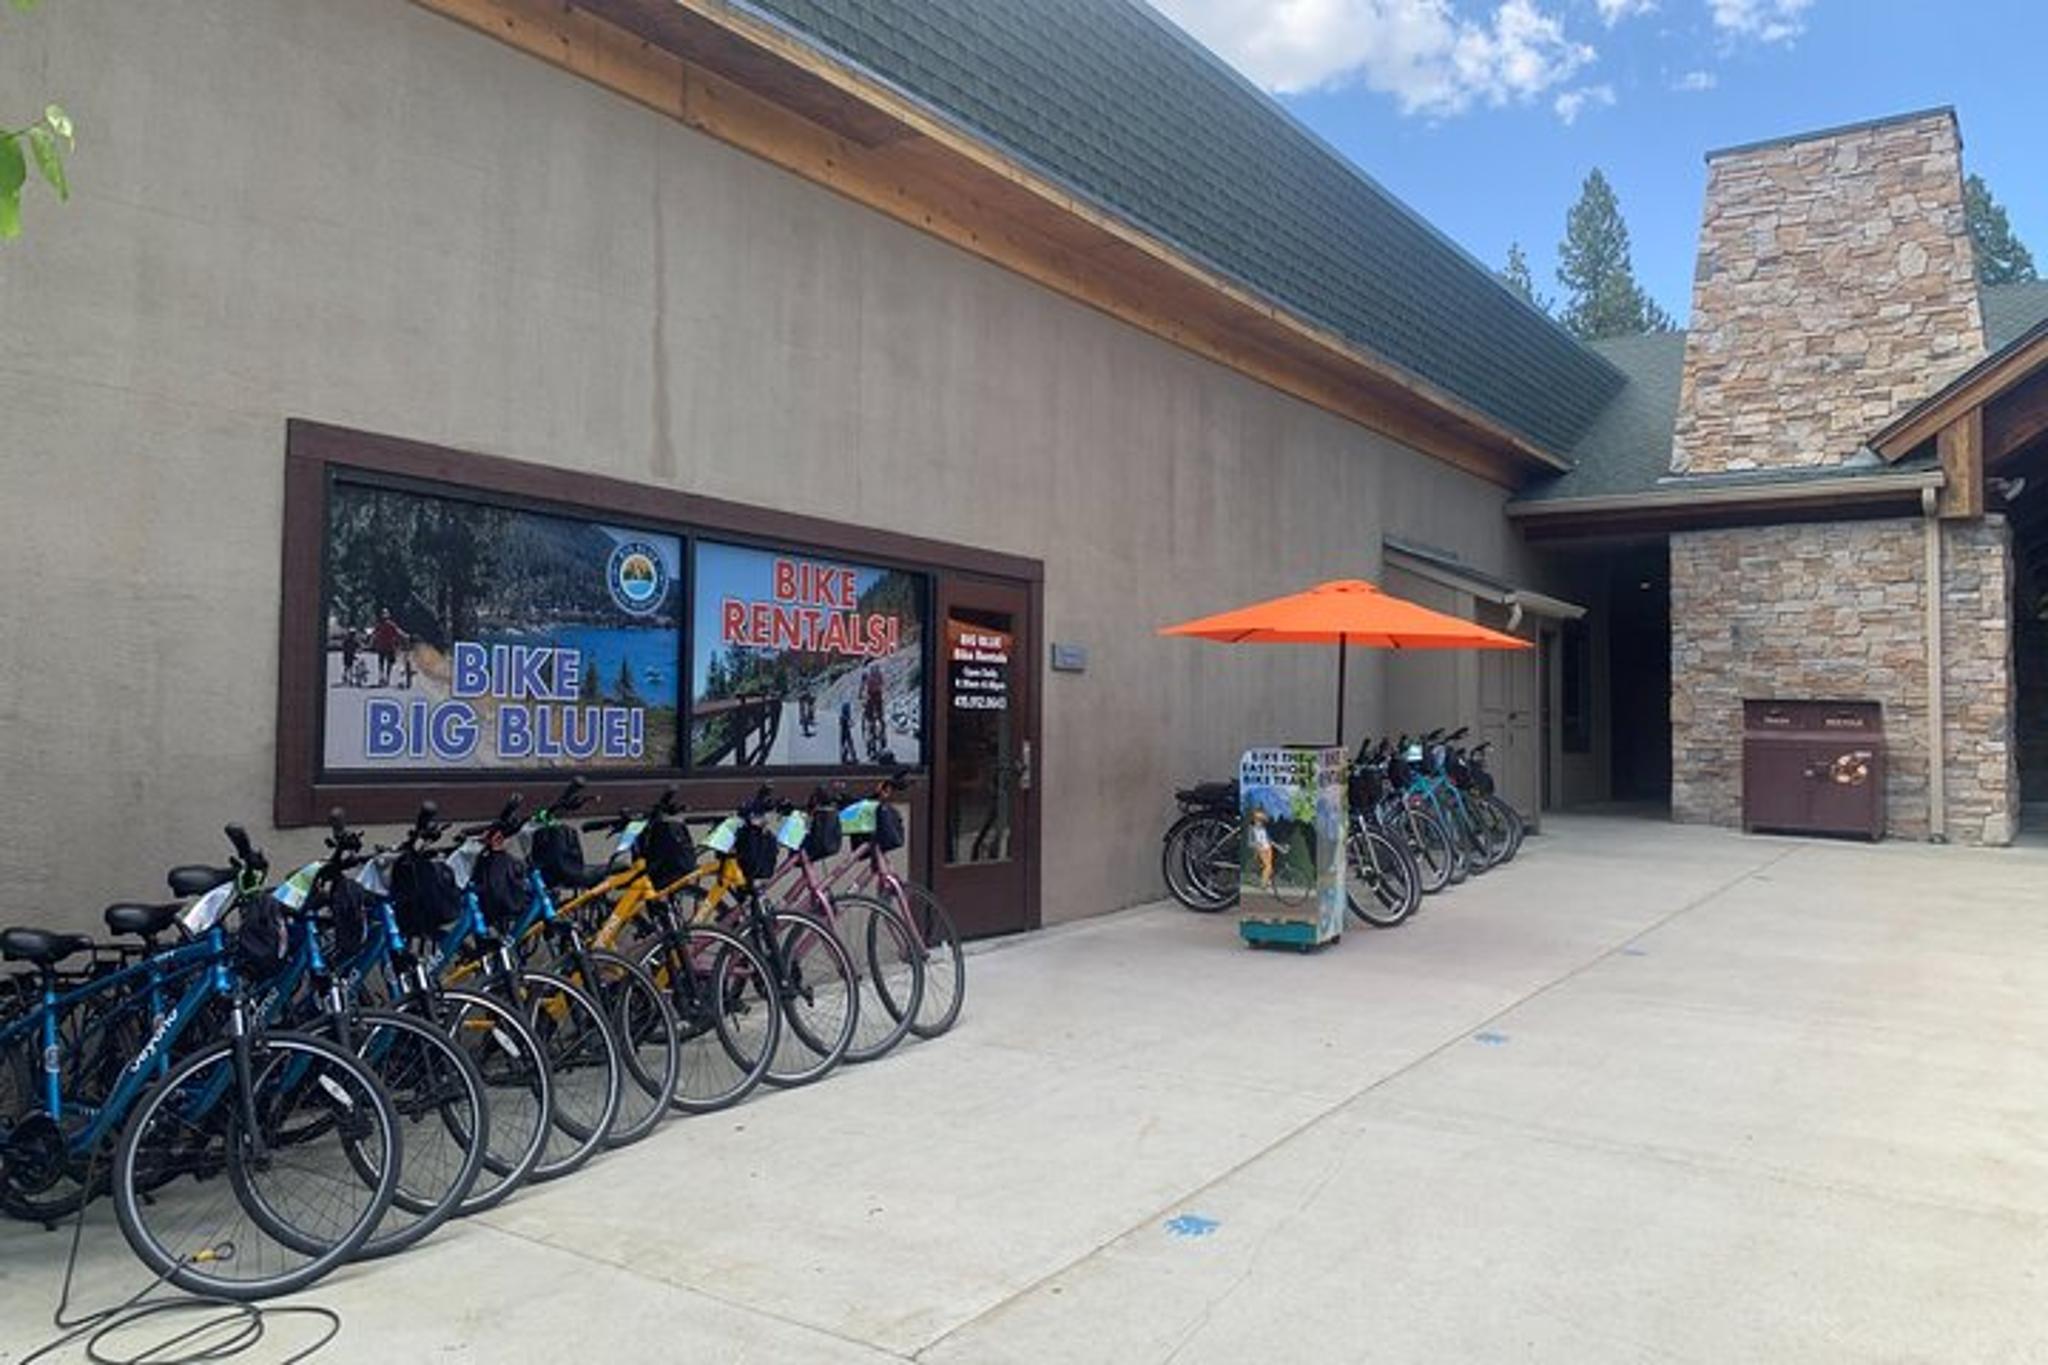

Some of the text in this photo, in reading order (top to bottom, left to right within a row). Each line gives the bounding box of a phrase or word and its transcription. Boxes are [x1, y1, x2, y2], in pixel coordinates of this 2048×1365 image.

[774, 559, 857, 608] BIKE
[721, 597, 899, 657] RENTALS!
[453, 641, 581, 700] BIKE
[364, 699, 645, 760] BIG BLUE!
